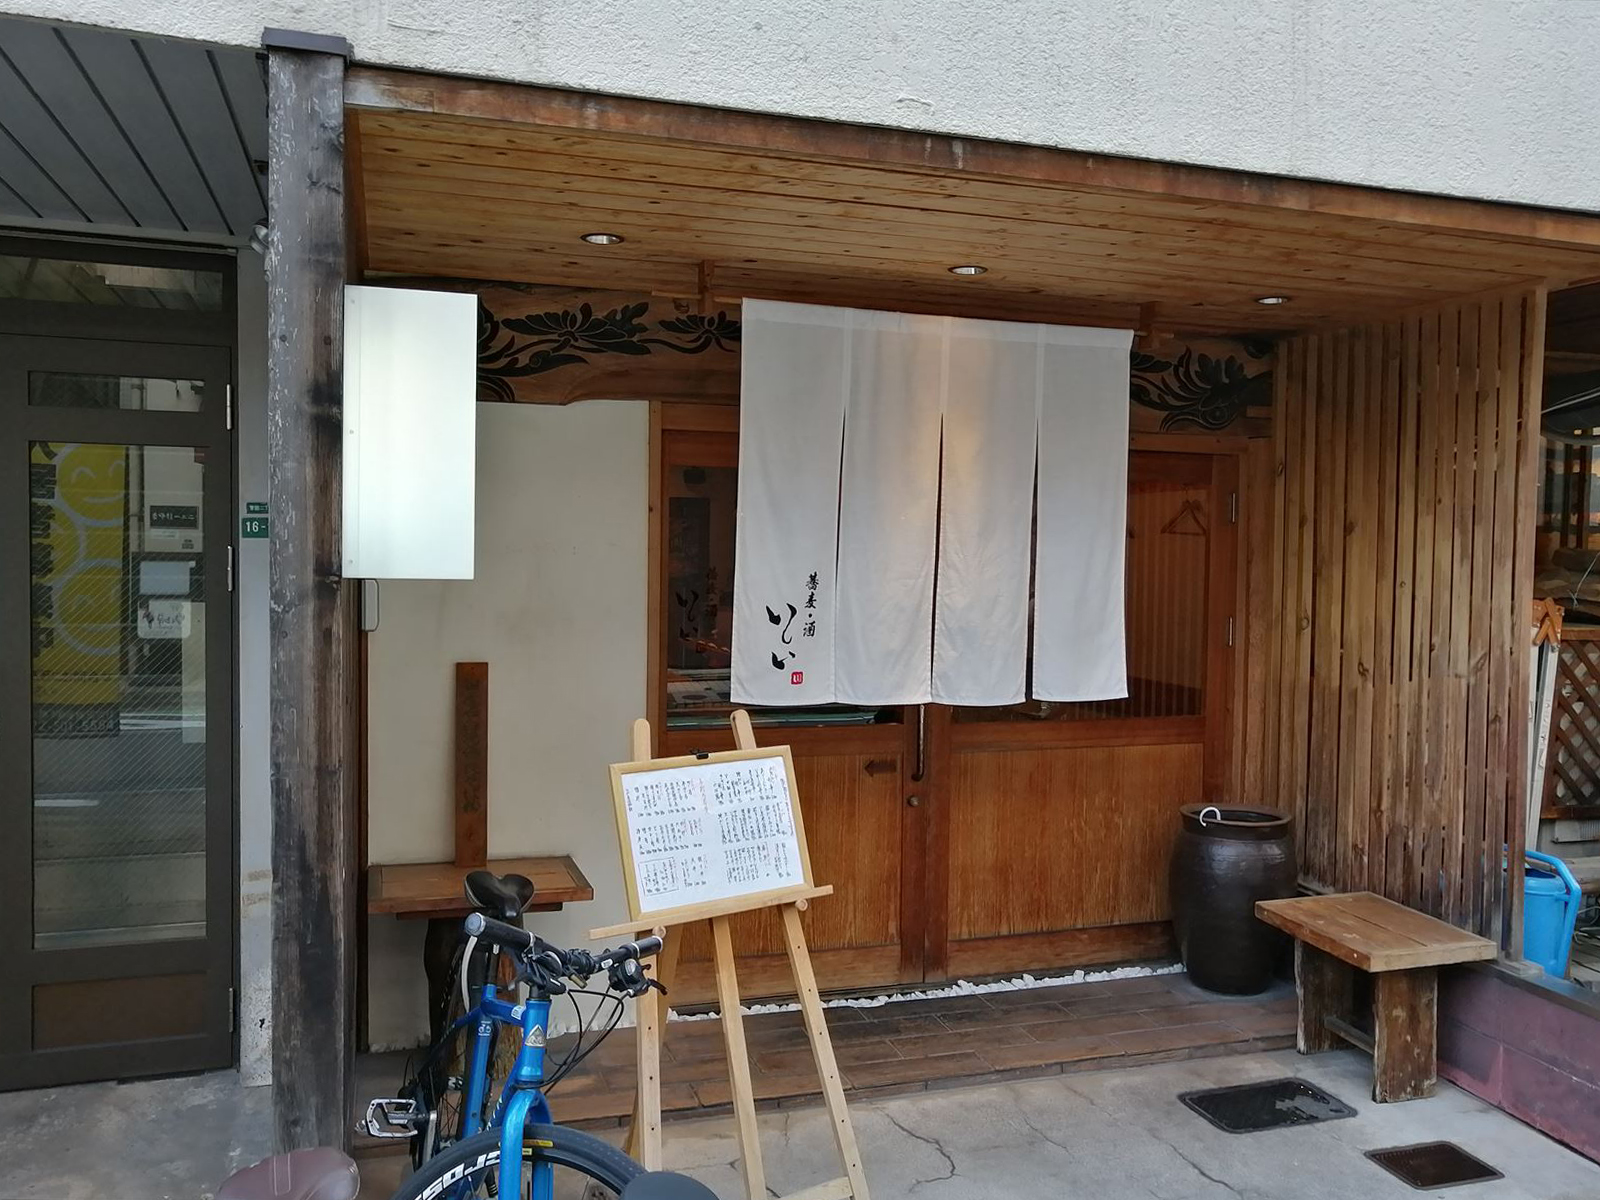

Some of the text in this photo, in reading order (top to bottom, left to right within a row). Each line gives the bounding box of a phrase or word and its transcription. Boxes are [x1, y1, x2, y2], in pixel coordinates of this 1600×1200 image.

[765, 602, 798, 671] いしい
[803, 571, 820, 637] 蕎麦・酒
